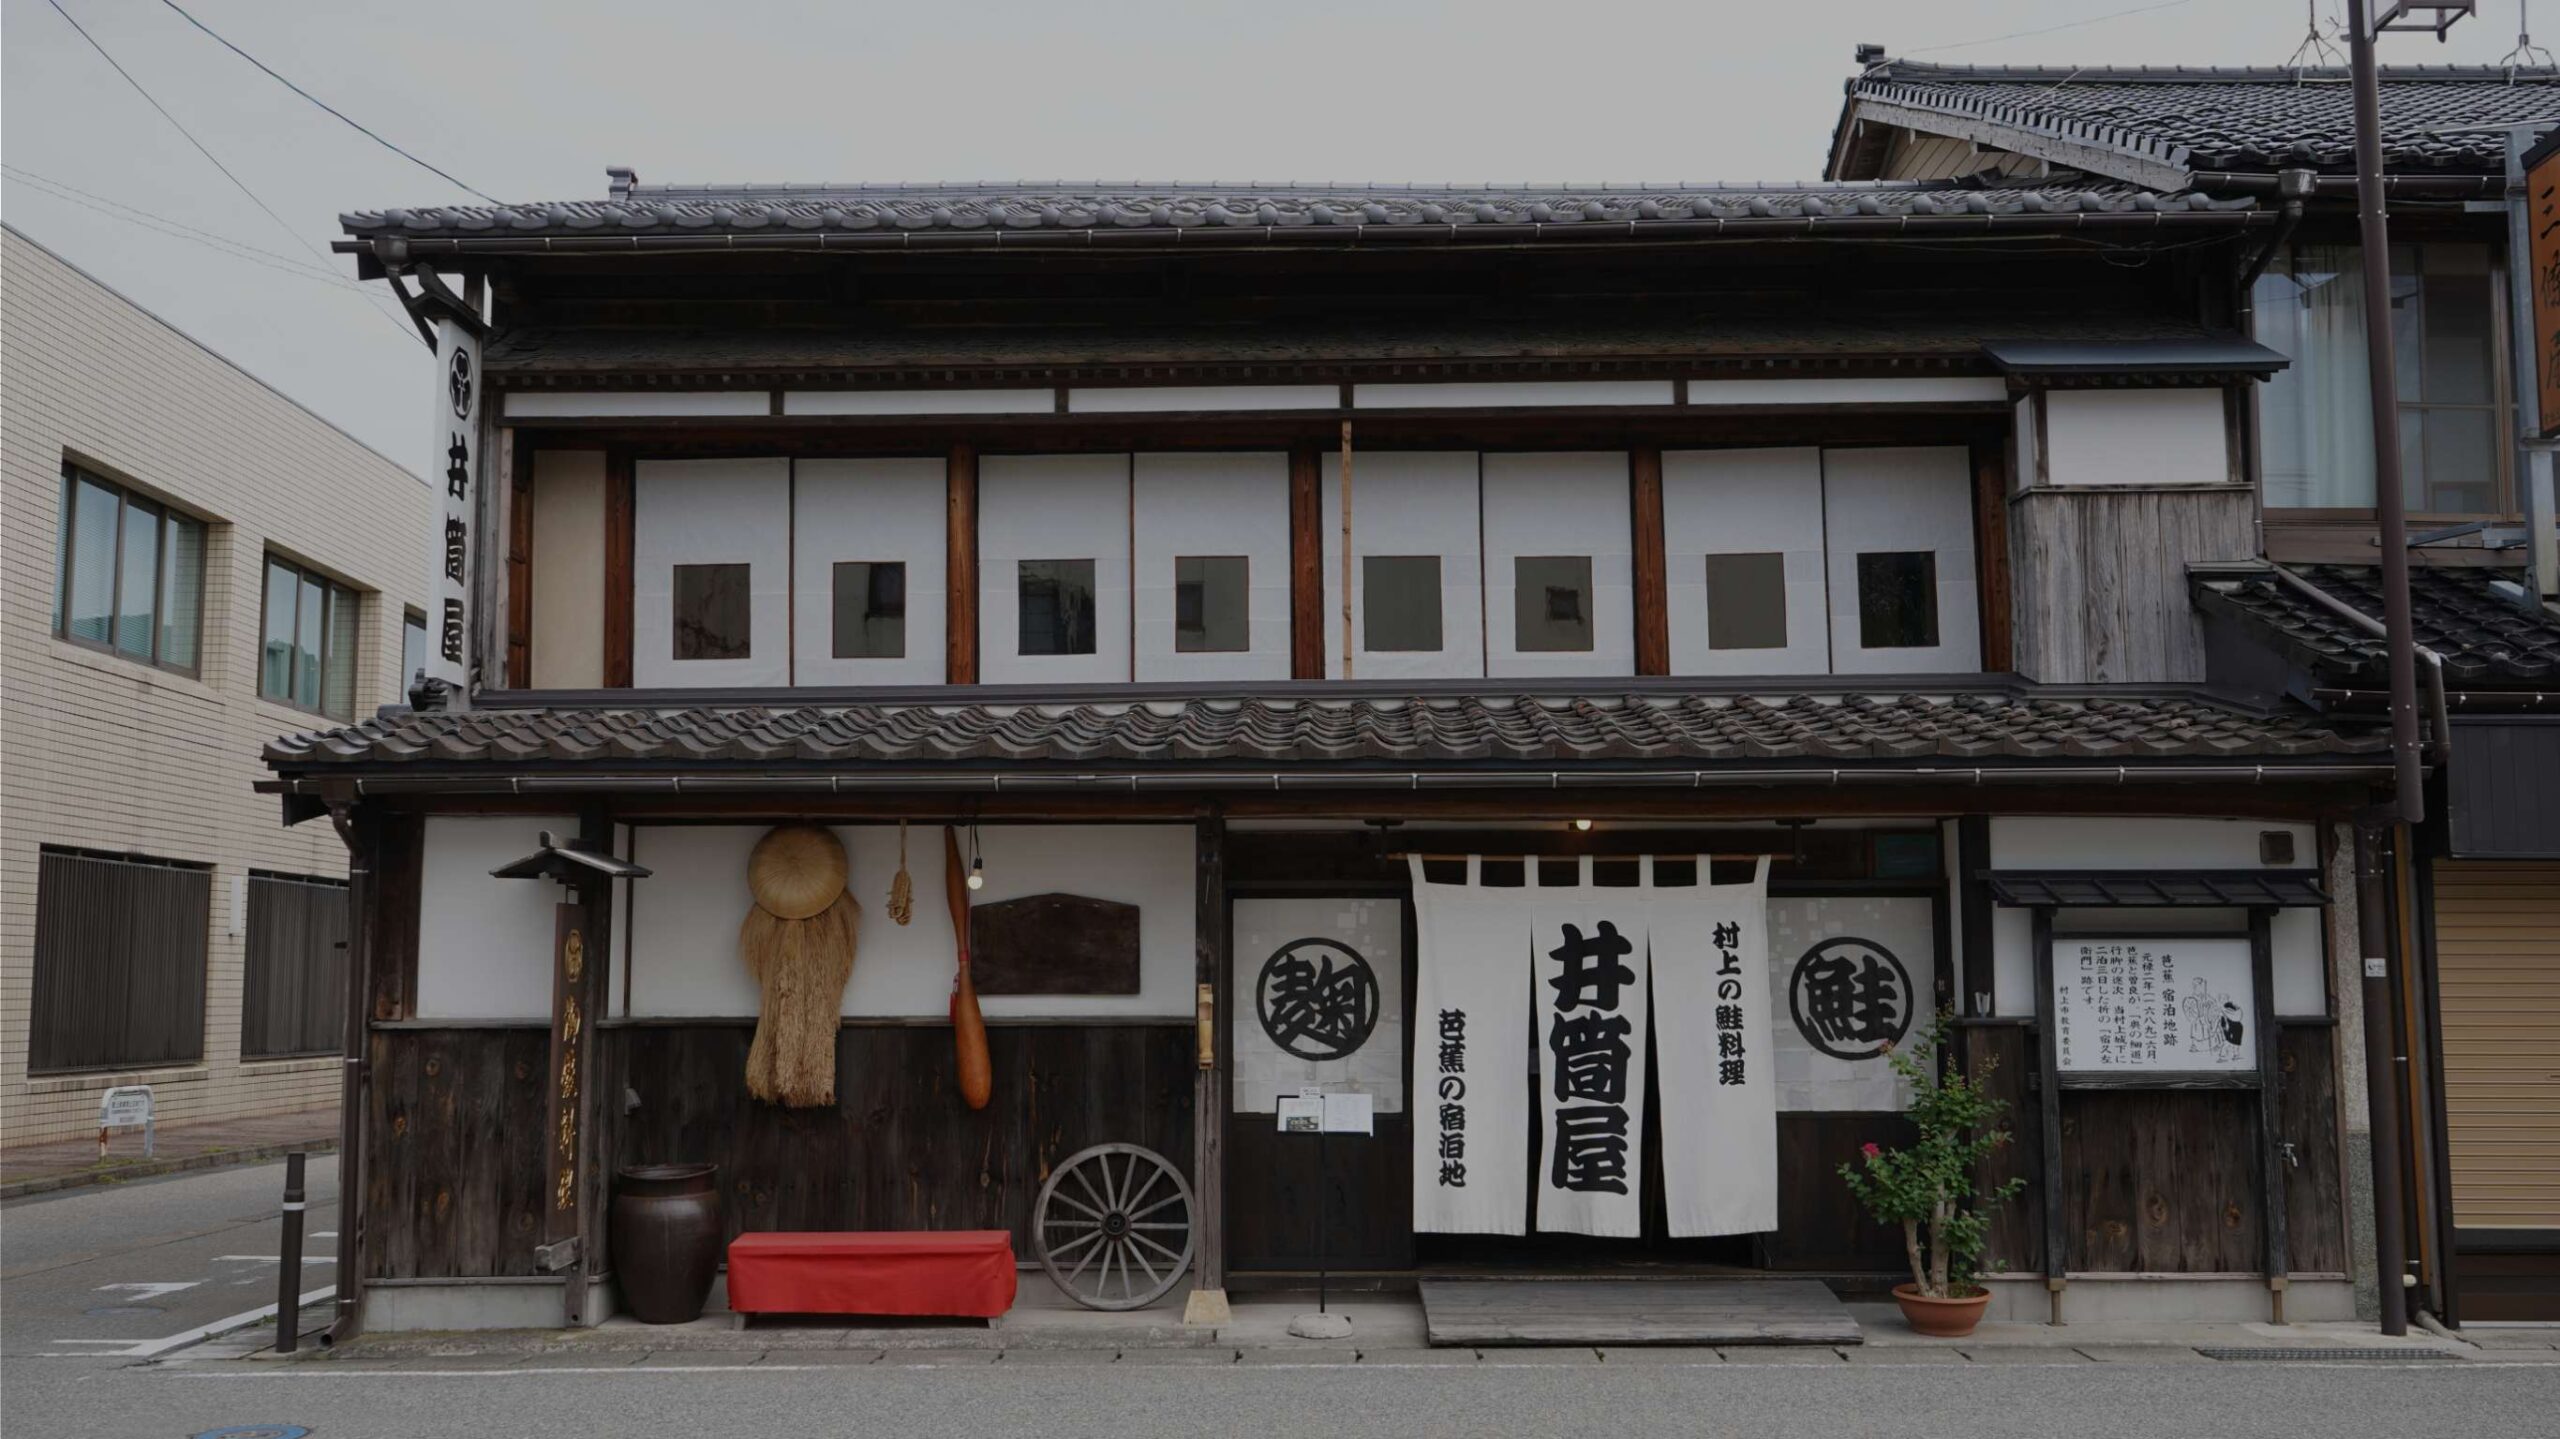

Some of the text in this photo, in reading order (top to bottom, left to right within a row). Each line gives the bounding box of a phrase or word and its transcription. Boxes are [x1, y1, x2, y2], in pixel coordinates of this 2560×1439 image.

[442, 432, 469, 665] 井筒屋
[1548, 920, 1636, 1195] 井筒屋
[1712, 921, 1746, 1086] 村上の鮭料理
[1802, 952, 1902, 1044] 鮭
[2059, 985, 2072, 1066] 村上市教育委員会
[1438, 1008, 1467, 1188] 芭蕉の宿泊地
